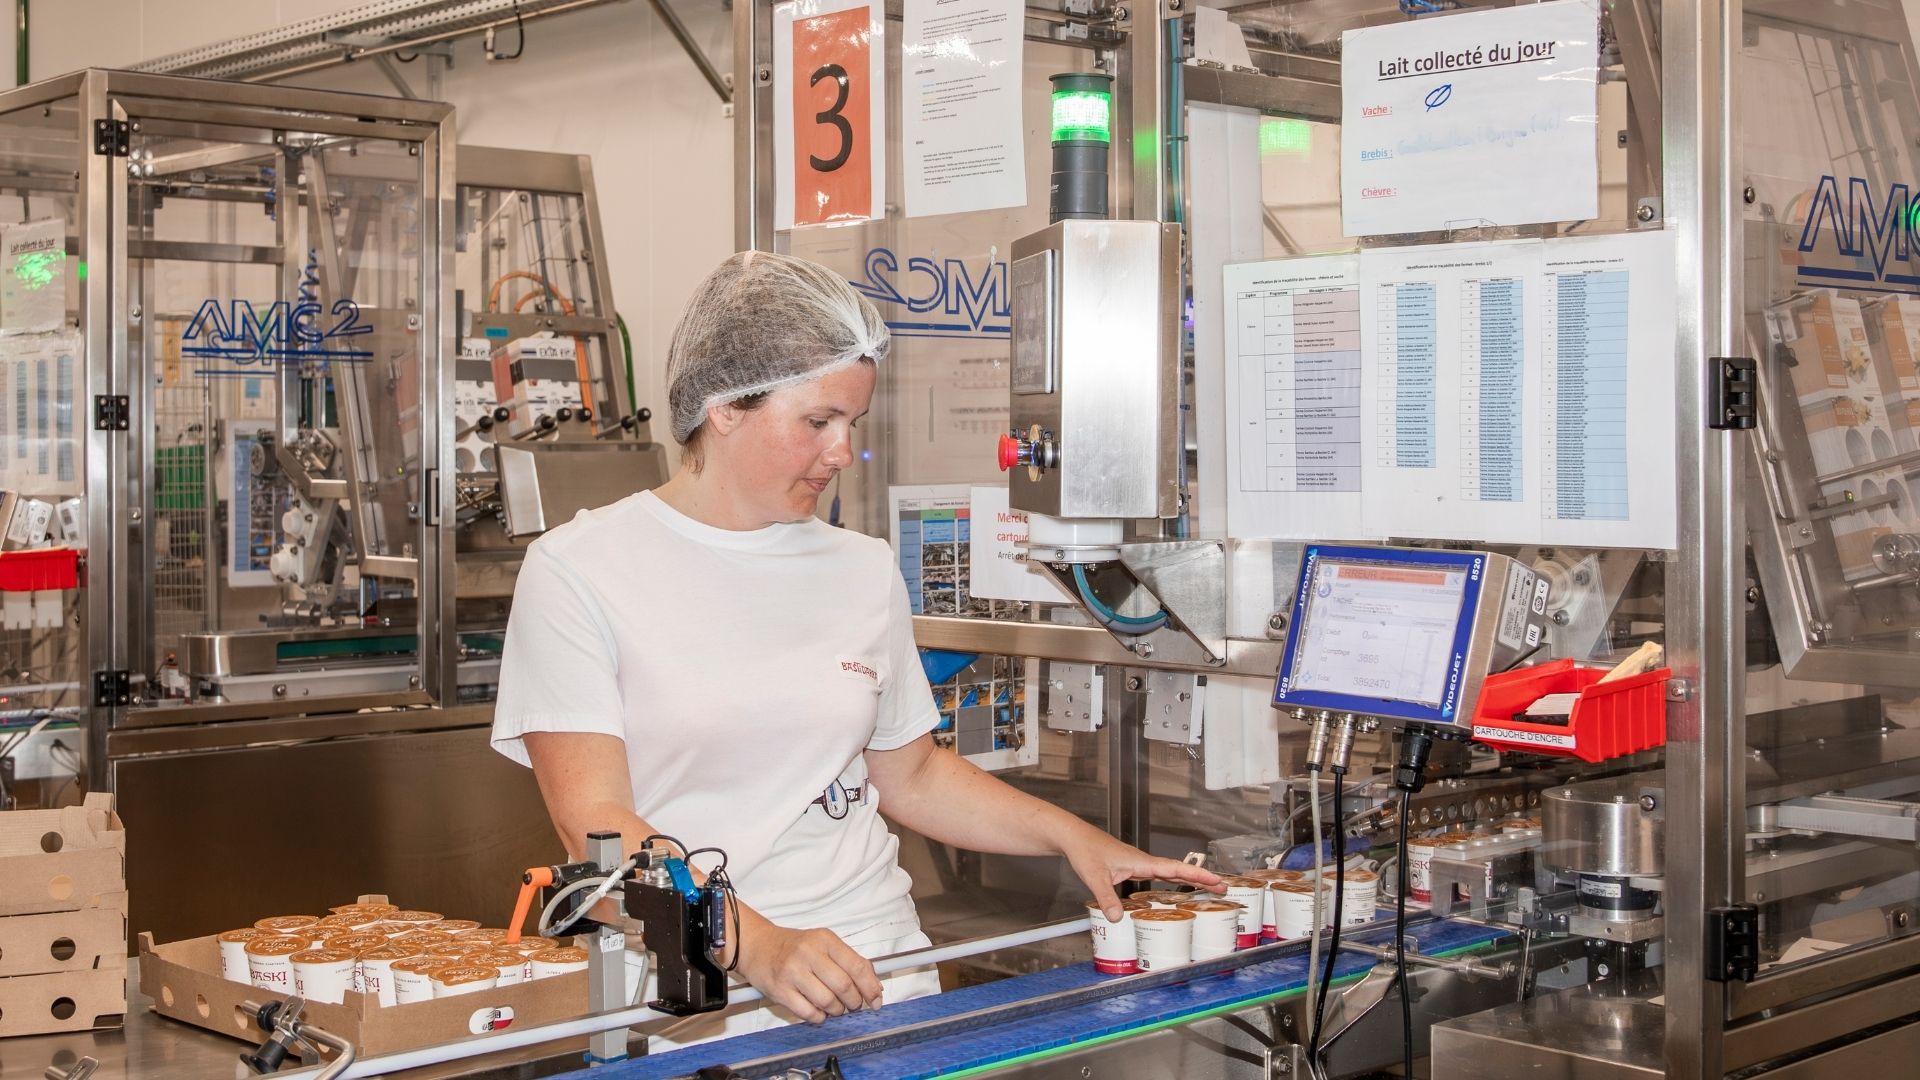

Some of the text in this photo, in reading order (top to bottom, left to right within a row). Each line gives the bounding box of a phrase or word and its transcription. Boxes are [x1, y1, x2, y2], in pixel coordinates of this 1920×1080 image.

[1379, 40, 1556, 77] Lait collecté du jour
[810, 63, 853, 172] 3
[1362, 105, 1388, 117] Vache
[1361, 148, 1388, 160] Brebis
[1361, 186, 1392, 198] Chèvre
[997, 512, 1022, 523] Merci
[997, 532, 1029, 543] cartouc
[1471, 558, 1482, 581] 8520
[1298, 552, 1317, 609] VIDEOJET
[1279, 677, 1289, 699] 8520
[1444, 652, 1462, 712] VIDEOJET
[1474, 727, 1564, 745] CARTOUCHE D'ENCRE
